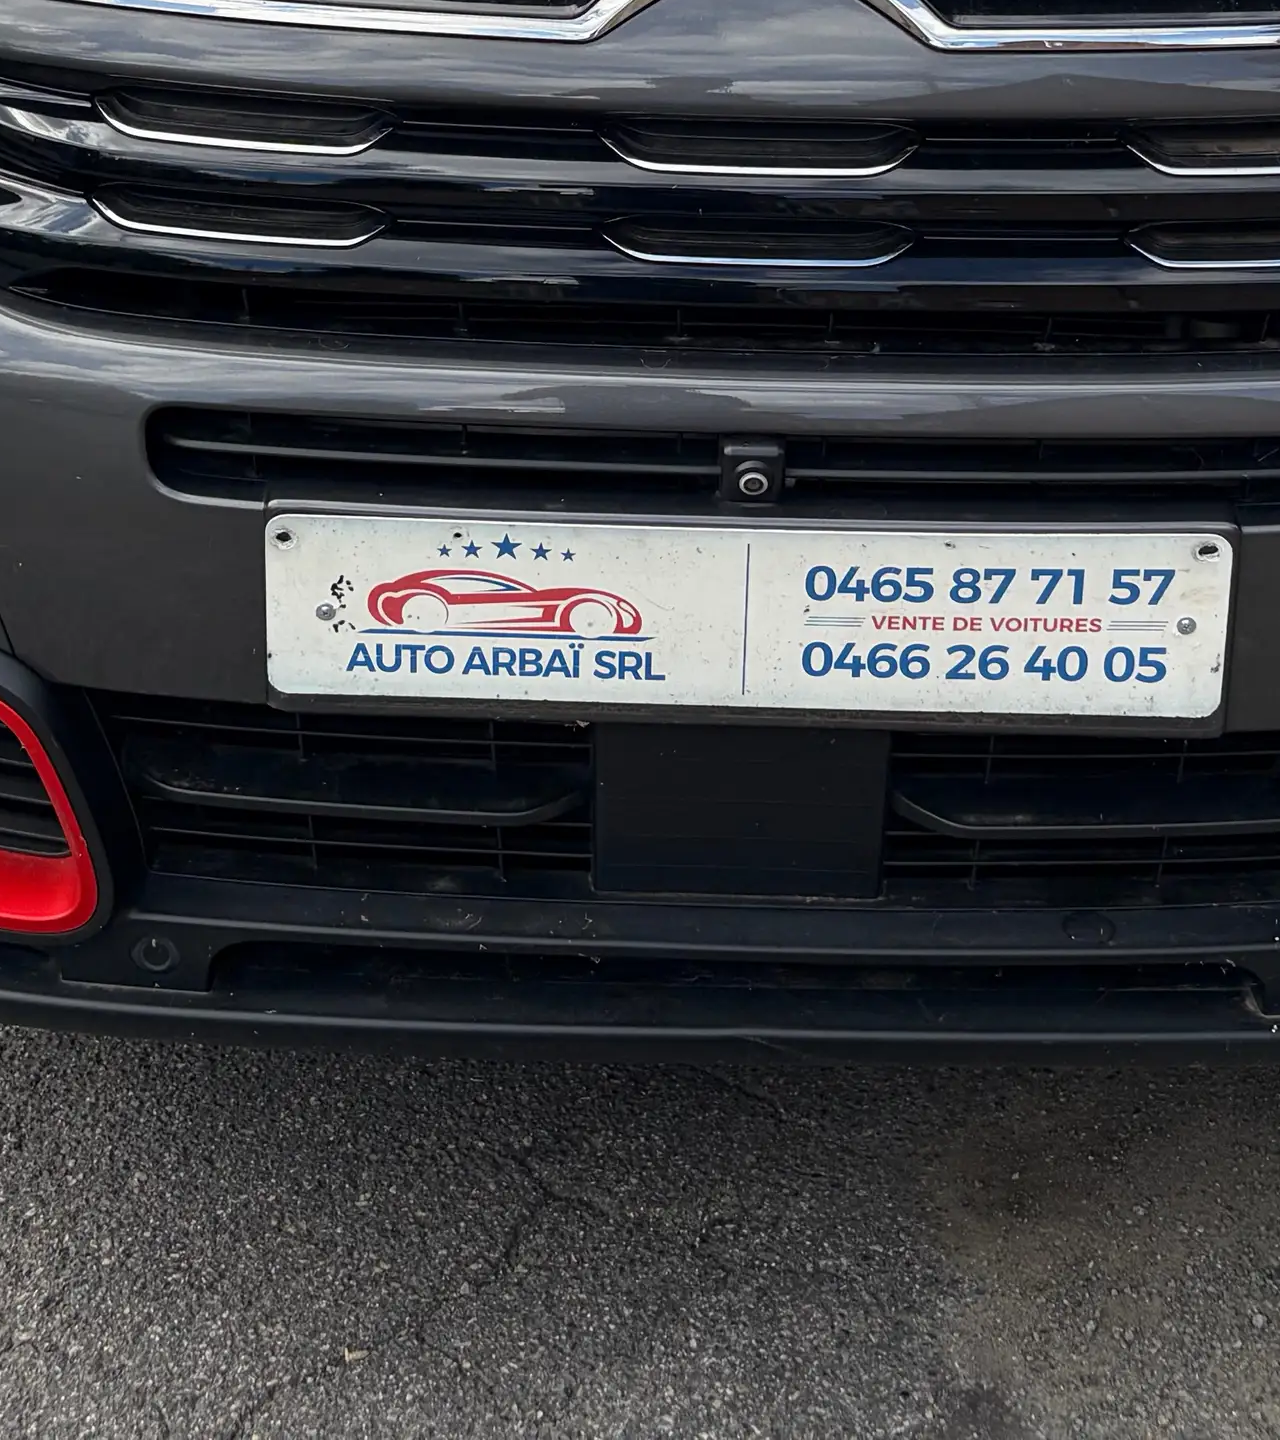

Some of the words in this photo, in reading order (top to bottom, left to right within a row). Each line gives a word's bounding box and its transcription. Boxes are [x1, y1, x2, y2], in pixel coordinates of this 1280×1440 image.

[805, 565, 935, 604] 0465
[949, 567, 1017, 605] 87
[1030, 568, 1086, 605] 71
[1108, 568, 1176, 606] 57
[871, 615, 946, 632] VENTE
[952, 616, 983, 633] DE
[989, 616, 1103, 633] VOITURES
[346, 642, 456, 675] AUTO
[461, 642, 585, 679] ARBAÏ
[593, 650, 667, 681] SRL
[801, 641, 931, 679] 0466
[945, 644, 1010, 681] 26
[1024, 645, 1089, 682] 40
[1103, 646, 1168, 684] 05
